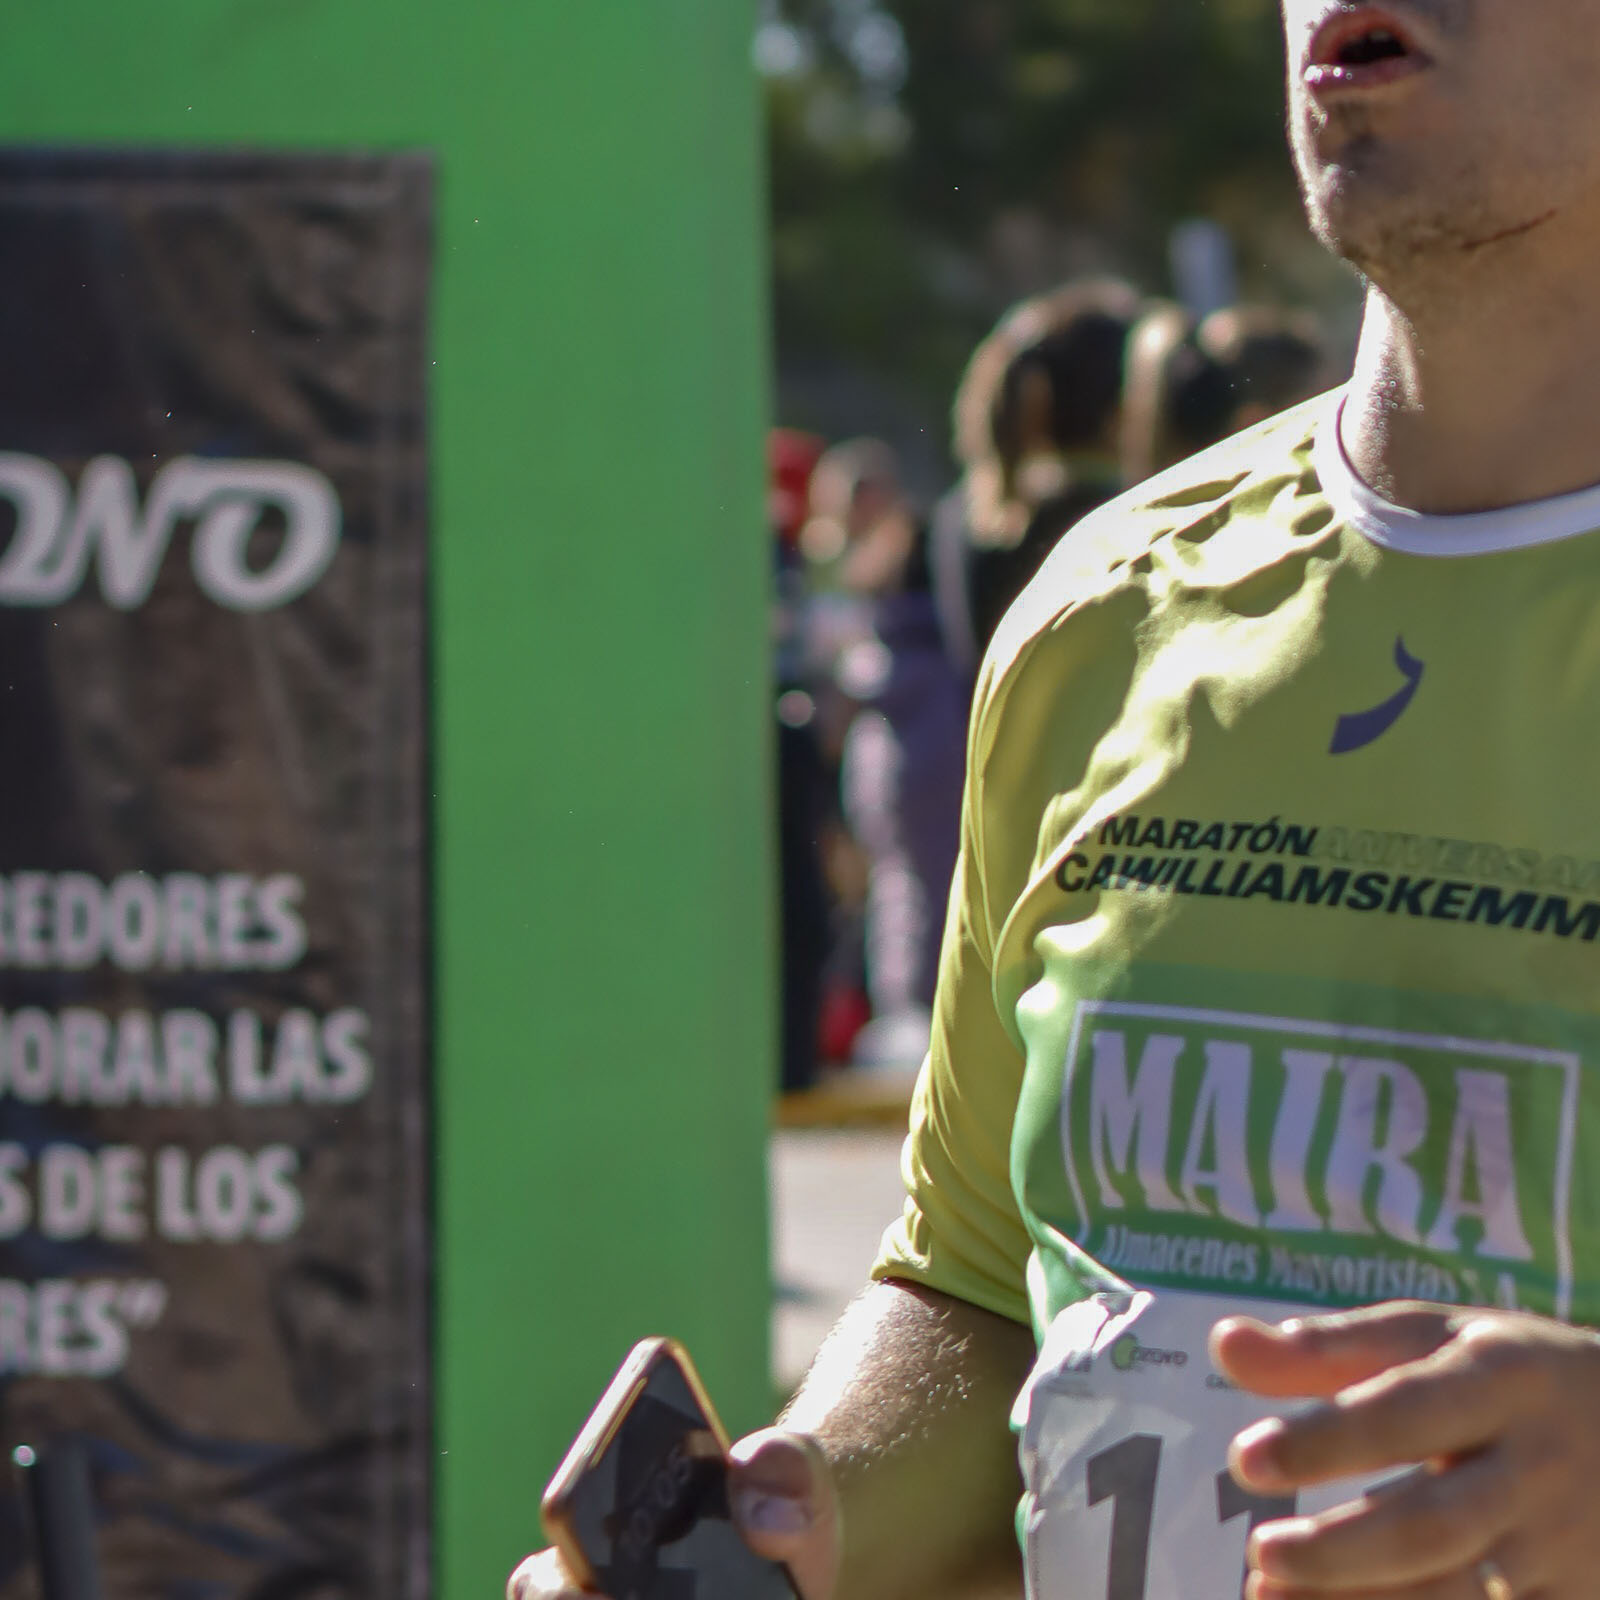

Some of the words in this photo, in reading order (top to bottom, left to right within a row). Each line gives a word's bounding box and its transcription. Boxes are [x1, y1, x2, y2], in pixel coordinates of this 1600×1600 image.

[1098, 814, 1319, 857] MARATÓN
[0, 868, 306, 971] EDORES
[0, 1006, 217, 1104] ORAR
[228, 1007, 373, 1104] LAS
[40, 1144, 146, 1242] DE
[154, 1145, 304, 1244] LOS
[1090, 1029, 1536, 1261] MAIRA
